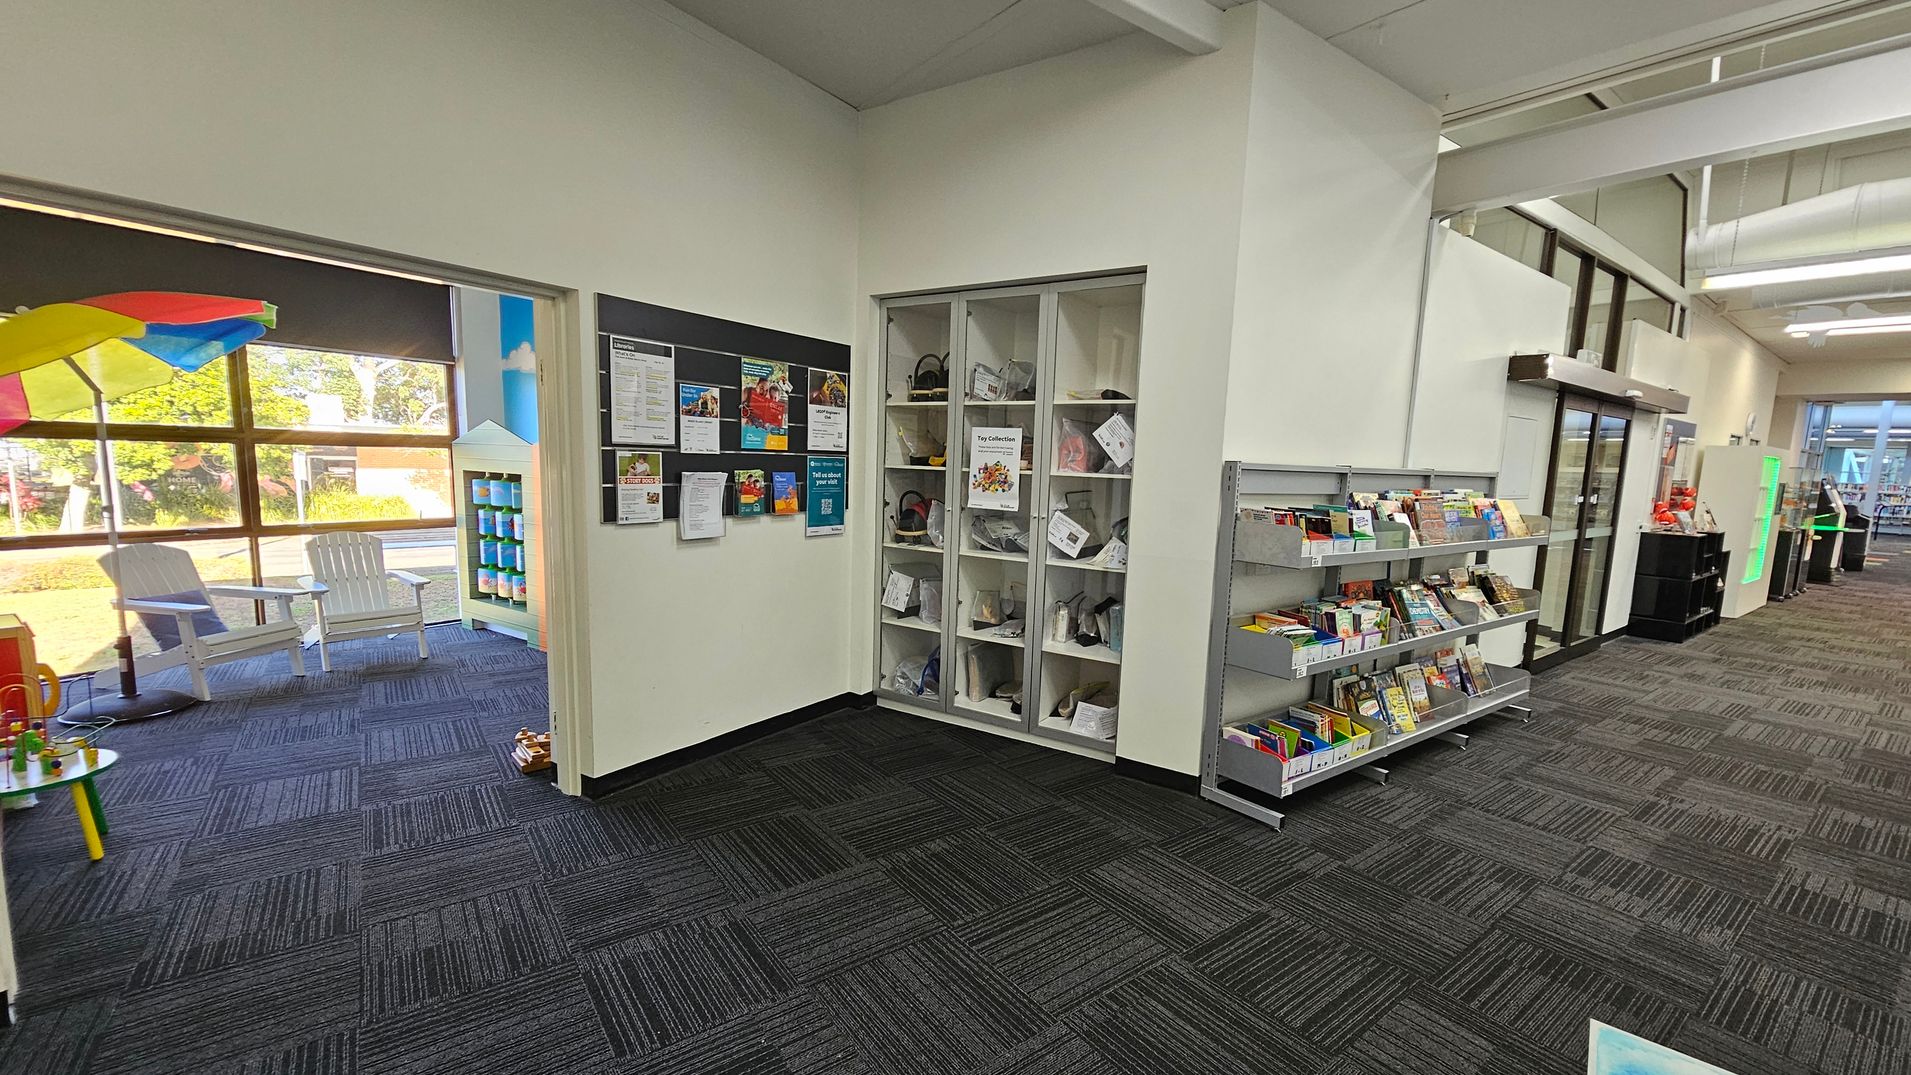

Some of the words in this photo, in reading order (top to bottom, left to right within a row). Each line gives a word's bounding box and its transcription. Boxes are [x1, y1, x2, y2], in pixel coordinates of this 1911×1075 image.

[613, 341, 635, 351] Libraries
[977, 435, 988, 443] Toy
[988, 435, 1016, 443] Collection
[815, 479, 827, 487] your
